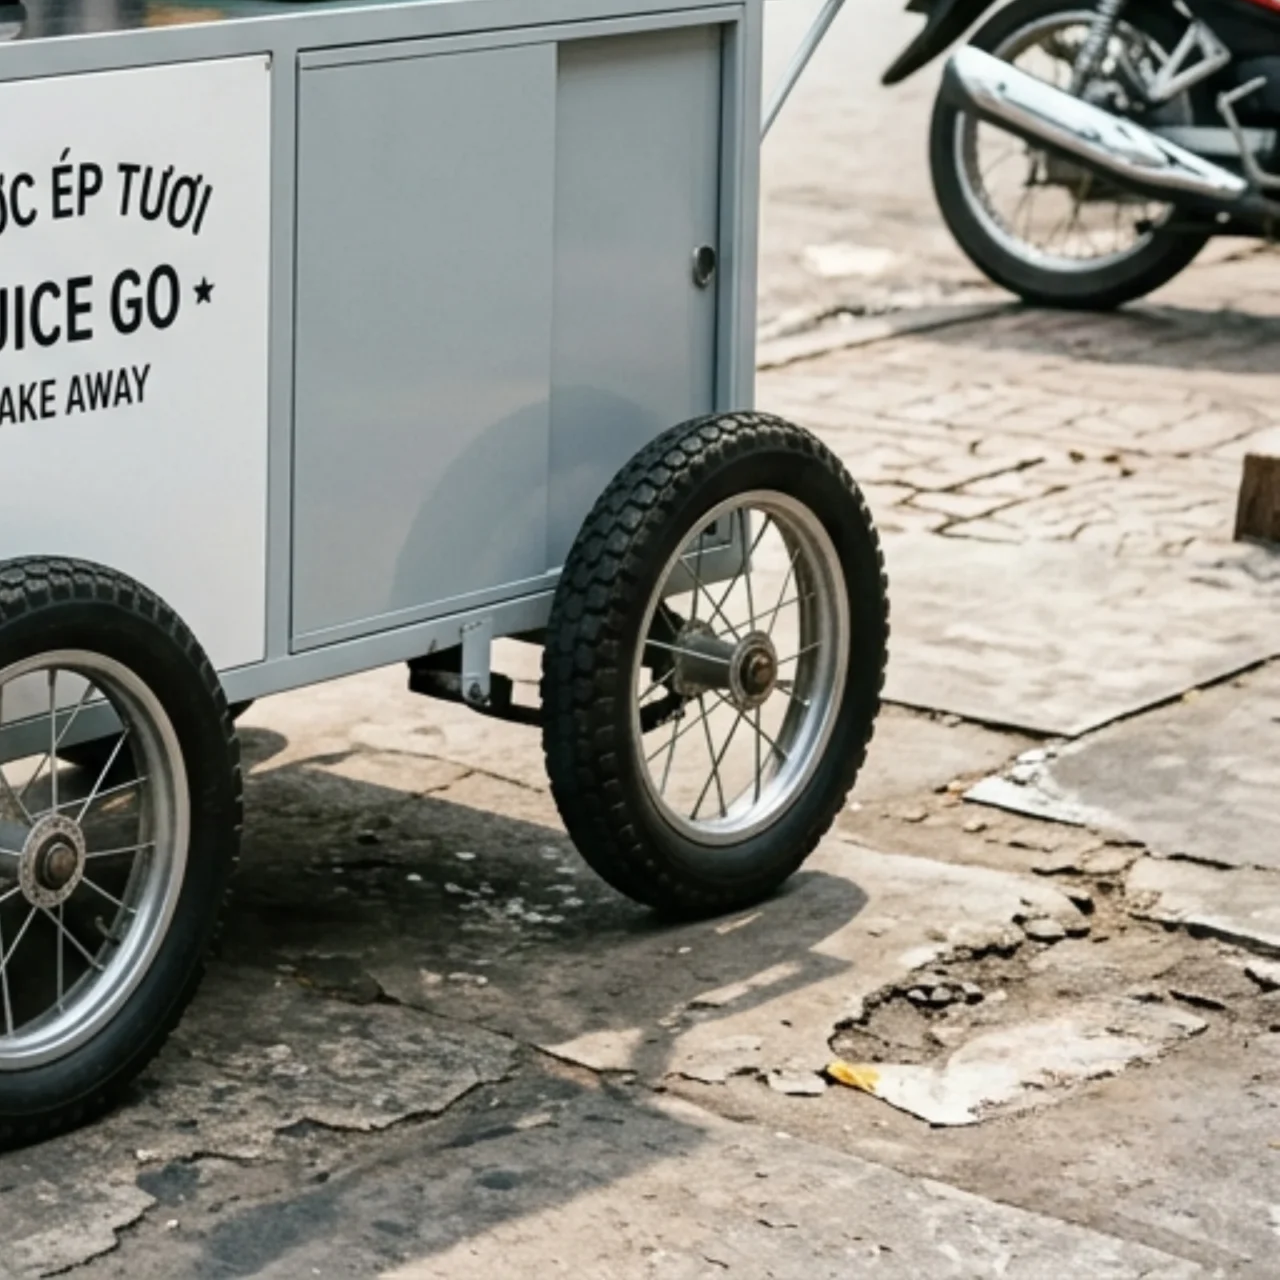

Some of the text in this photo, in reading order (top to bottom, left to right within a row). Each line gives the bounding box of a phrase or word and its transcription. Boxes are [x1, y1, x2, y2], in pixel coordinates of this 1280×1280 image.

[52, 148, 102, 218] ÉP
[118, 163, 212, 235] TƯƠI
[111, 265, 179, 334] GO
[66, 364, 150, 414] AWAY
